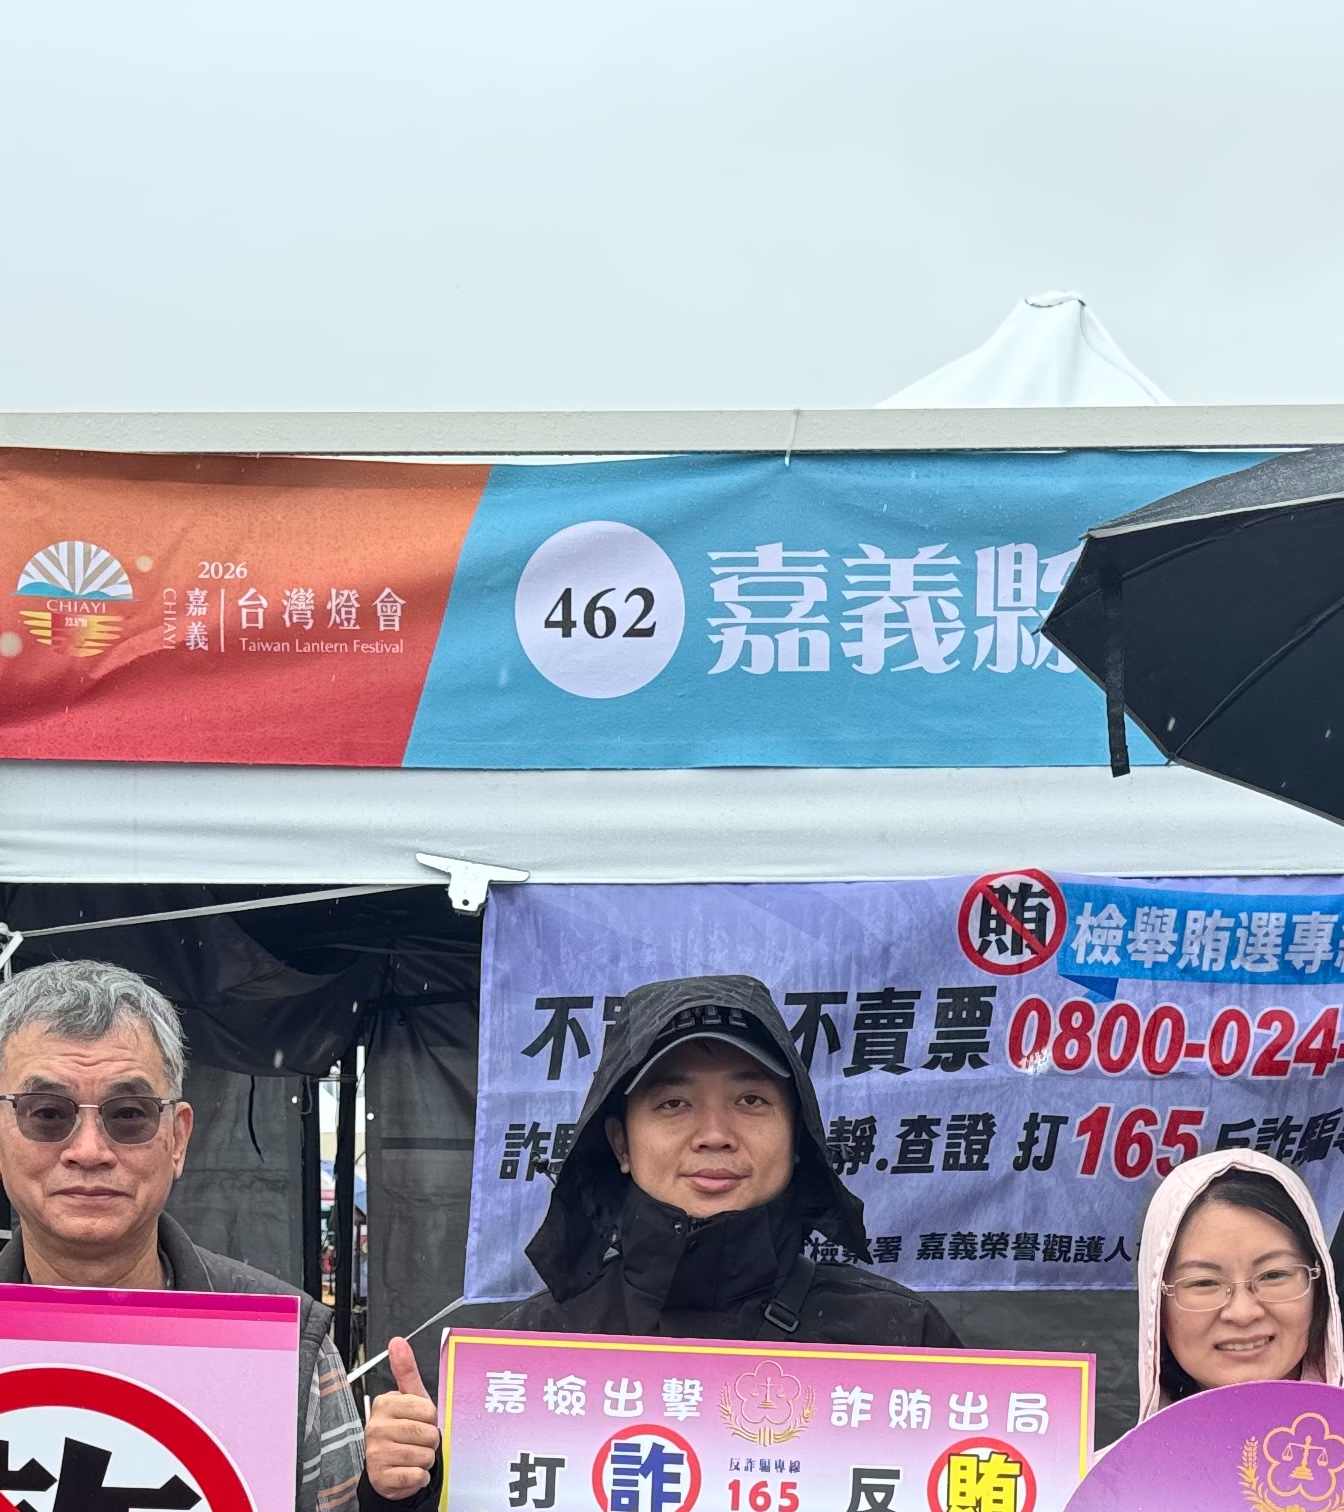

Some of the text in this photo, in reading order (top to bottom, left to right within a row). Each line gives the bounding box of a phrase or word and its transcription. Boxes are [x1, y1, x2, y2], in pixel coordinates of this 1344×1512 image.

[197, 561, 248, 579] 2026
[46, 600, 106, 614] CHIAYI
[162, 587, 177, 650] CHIAYI
[186, 587, 209, 652] 嘉義
[237, 586, 407, 632] 台灣燈會
[543, 586, 657, 640] 462
[240, 638, 405, 654] Taiwan Lantern Festival
[976, 883, 1052, 957] 賄
[1076, 1104, 1206, 1181] 165
[915, 1231, 1141, 1265] 嘉義榮譽觀護人
[483, 1369, 1051, 1436] 嘉檢出擊 詐賄出局
[509, 1452, 567, 1510] 打
